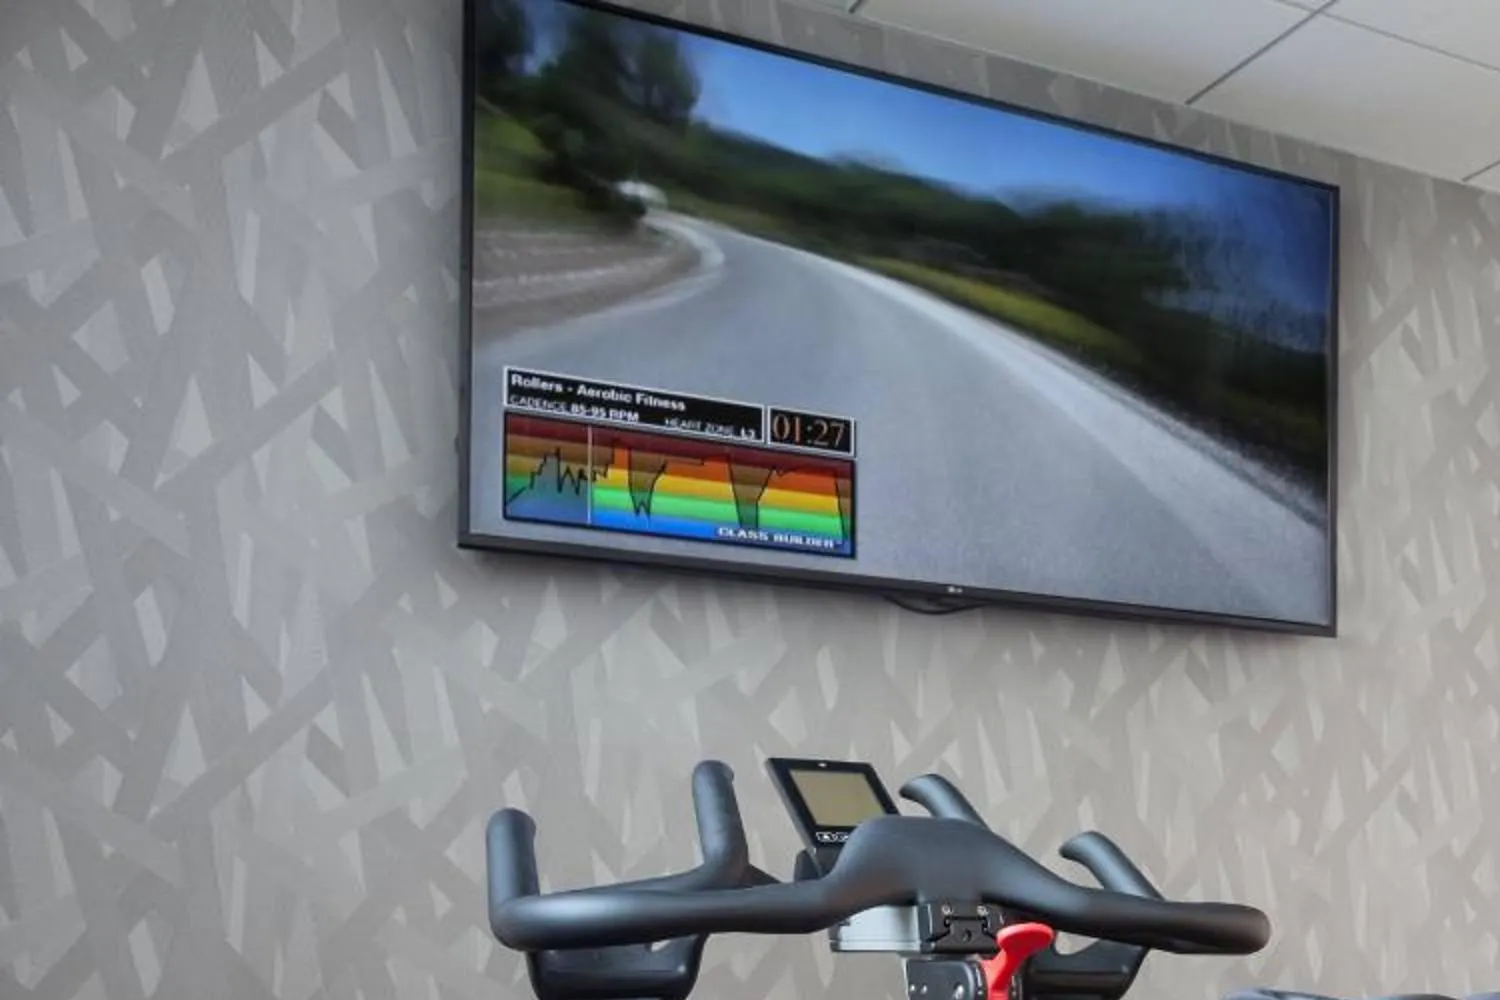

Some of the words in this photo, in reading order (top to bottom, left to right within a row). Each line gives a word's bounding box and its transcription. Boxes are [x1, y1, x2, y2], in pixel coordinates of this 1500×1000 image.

[510, 373, 564, 393] Rollers
[577, 384, 633, 403] Aerobic
[635, 393, 686, 412] Fitness
[608, 408, 640, 422] RPM
[772, 413, 846, 447] 01:27
[717, 527, 769, 541] CLASS
